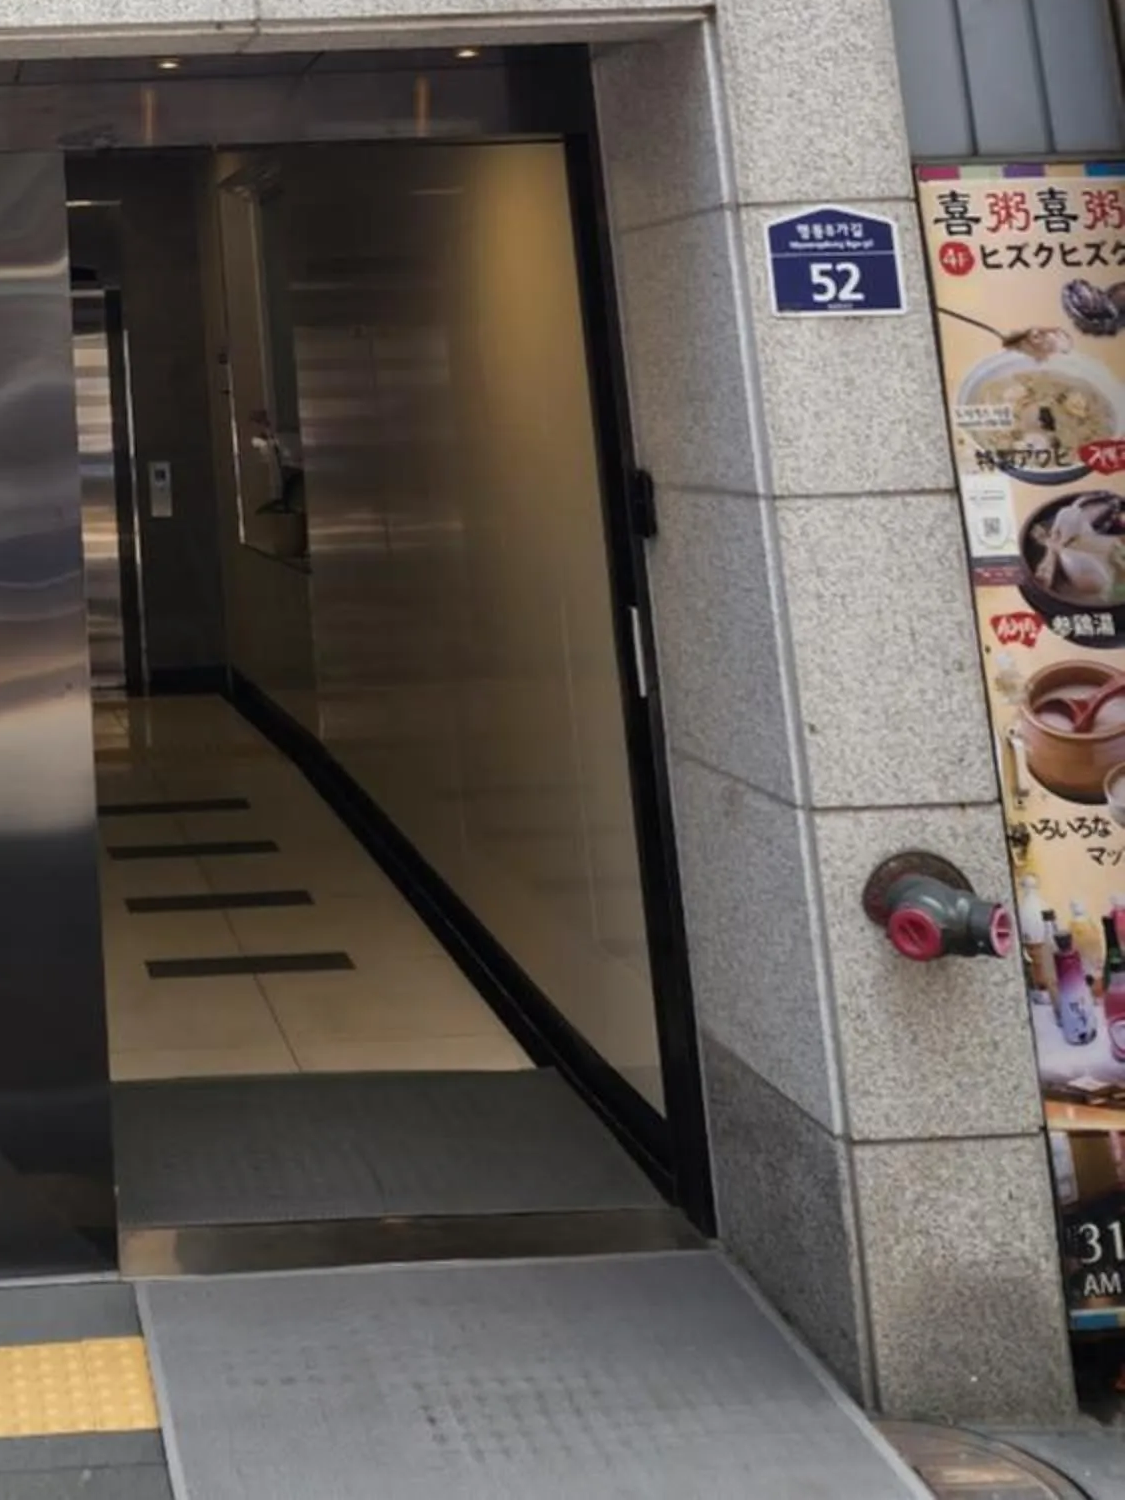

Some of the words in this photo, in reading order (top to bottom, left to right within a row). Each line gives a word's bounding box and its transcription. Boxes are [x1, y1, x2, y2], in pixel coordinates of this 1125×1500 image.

[810, 262, 865, 302] 52
[1030, 815, 1113, 841] いろいろな
[1083, 1271, 1122, 1297] AM
